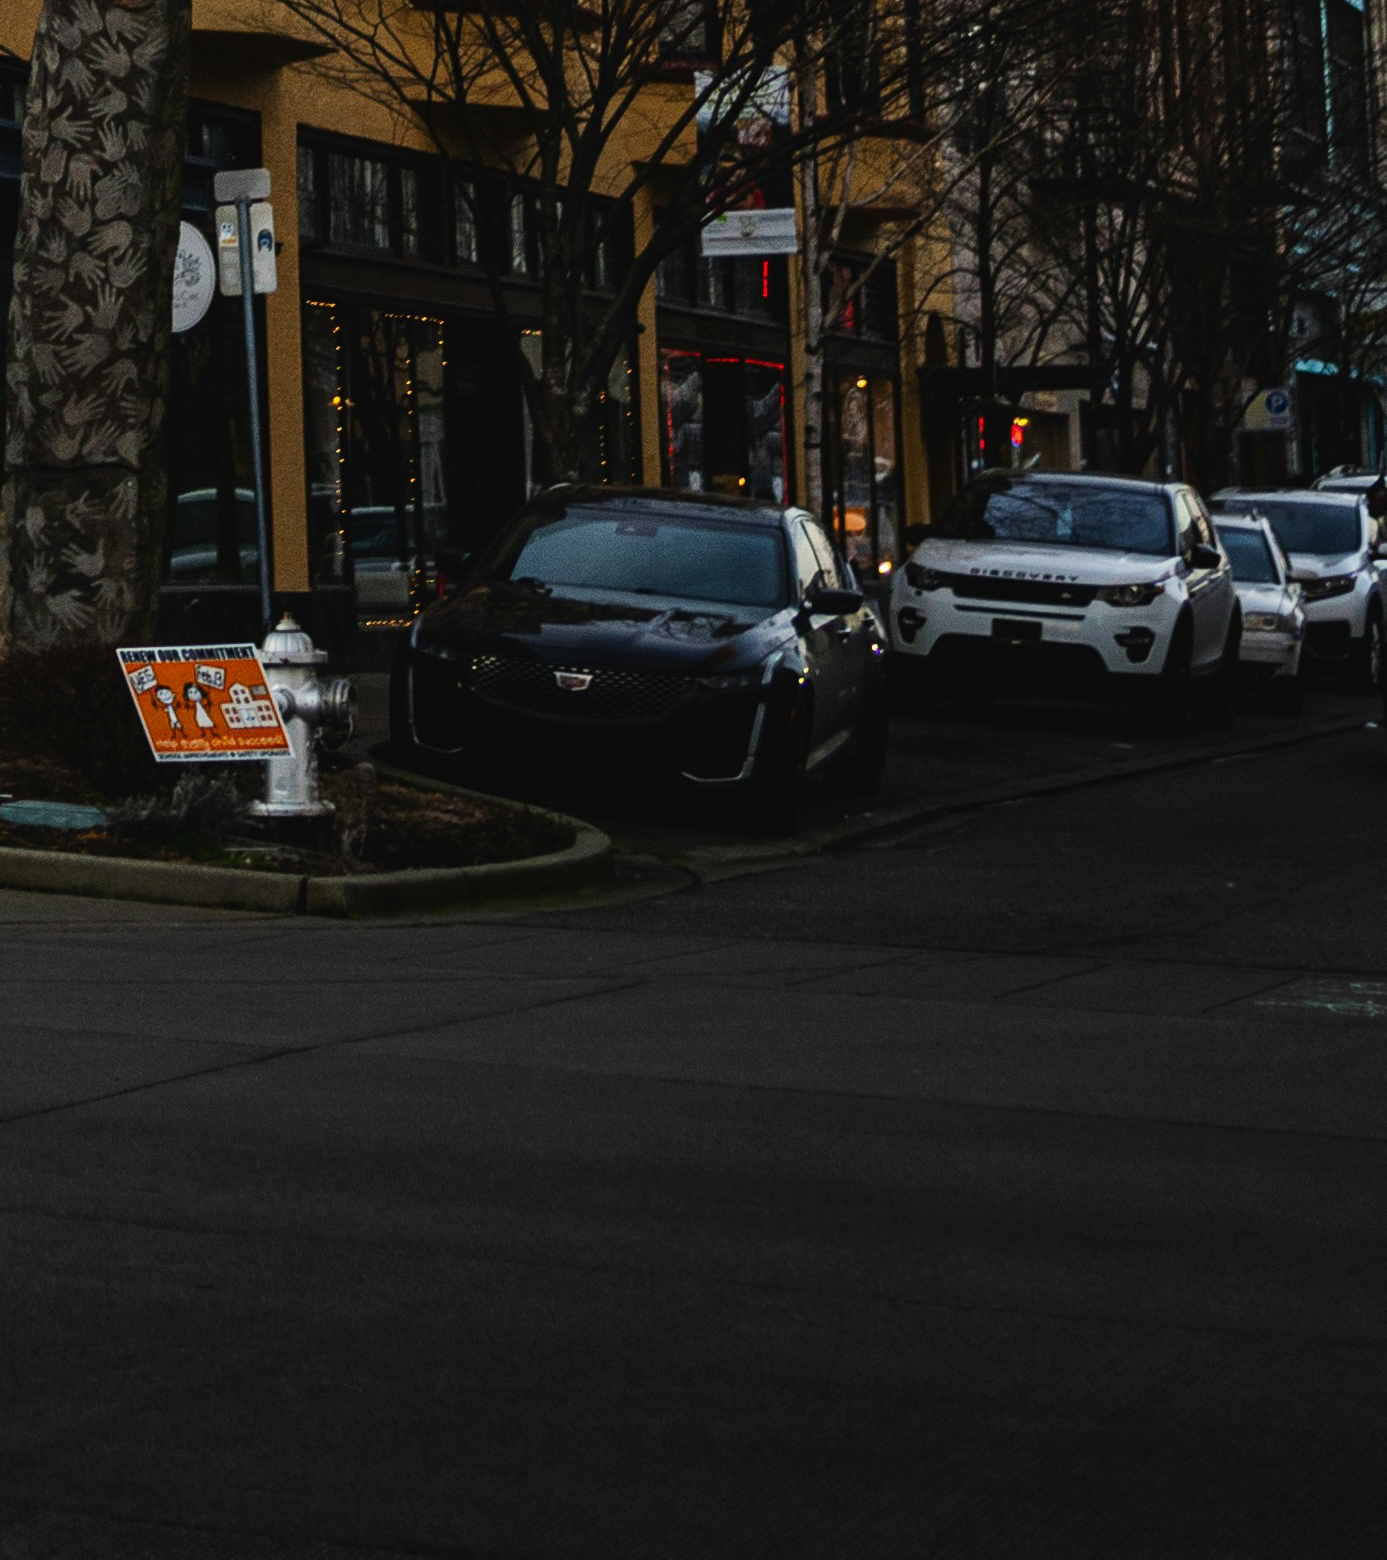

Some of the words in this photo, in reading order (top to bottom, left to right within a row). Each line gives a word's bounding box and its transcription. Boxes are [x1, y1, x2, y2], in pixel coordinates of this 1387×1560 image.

[970, 567, 1078, 582] DISCOVERY
[120, 650, 156, 663] RENEW
[157, 649, 180, 662] OUR
[181, 646, 256, 661] COMMITMENT
